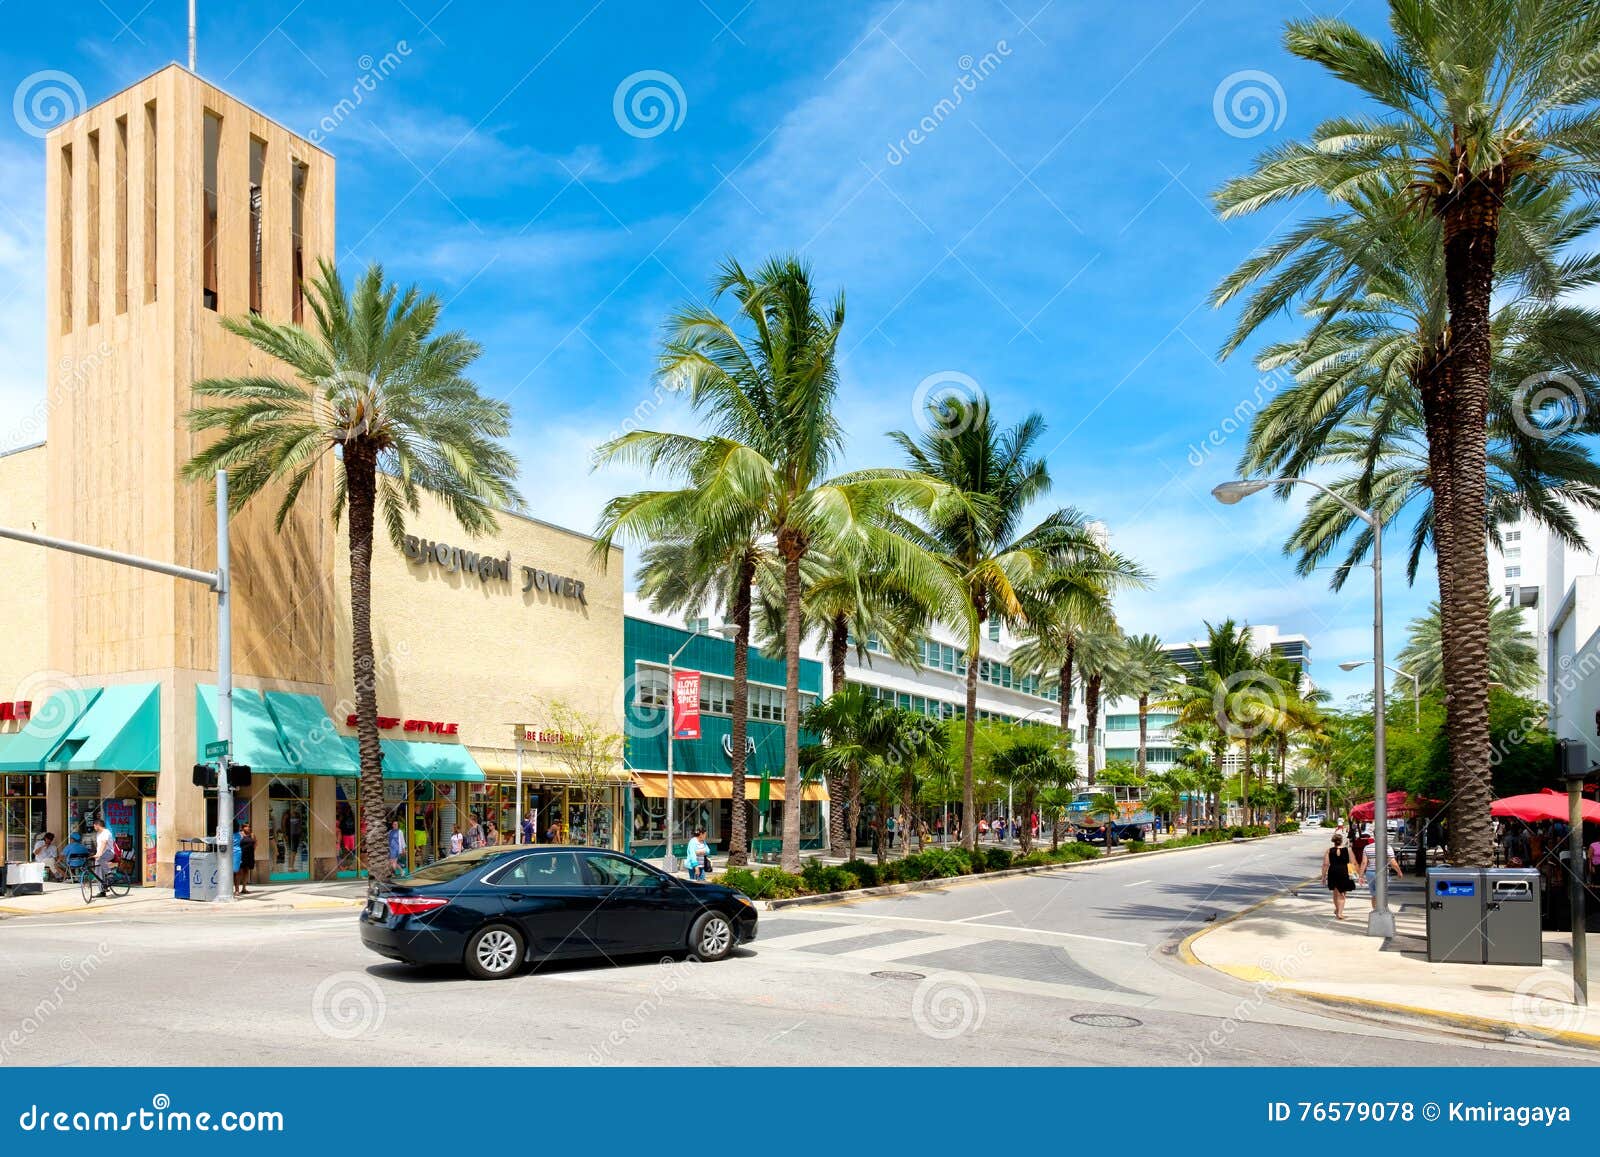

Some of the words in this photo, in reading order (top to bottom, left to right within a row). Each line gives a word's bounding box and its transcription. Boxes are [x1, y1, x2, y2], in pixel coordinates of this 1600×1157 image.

[678, 695, 698, 704] SPICE
[0, 701, 32, 720] LE
[403, 720, 459, 735] STYLE
[525, 730, 536, 741] BE
